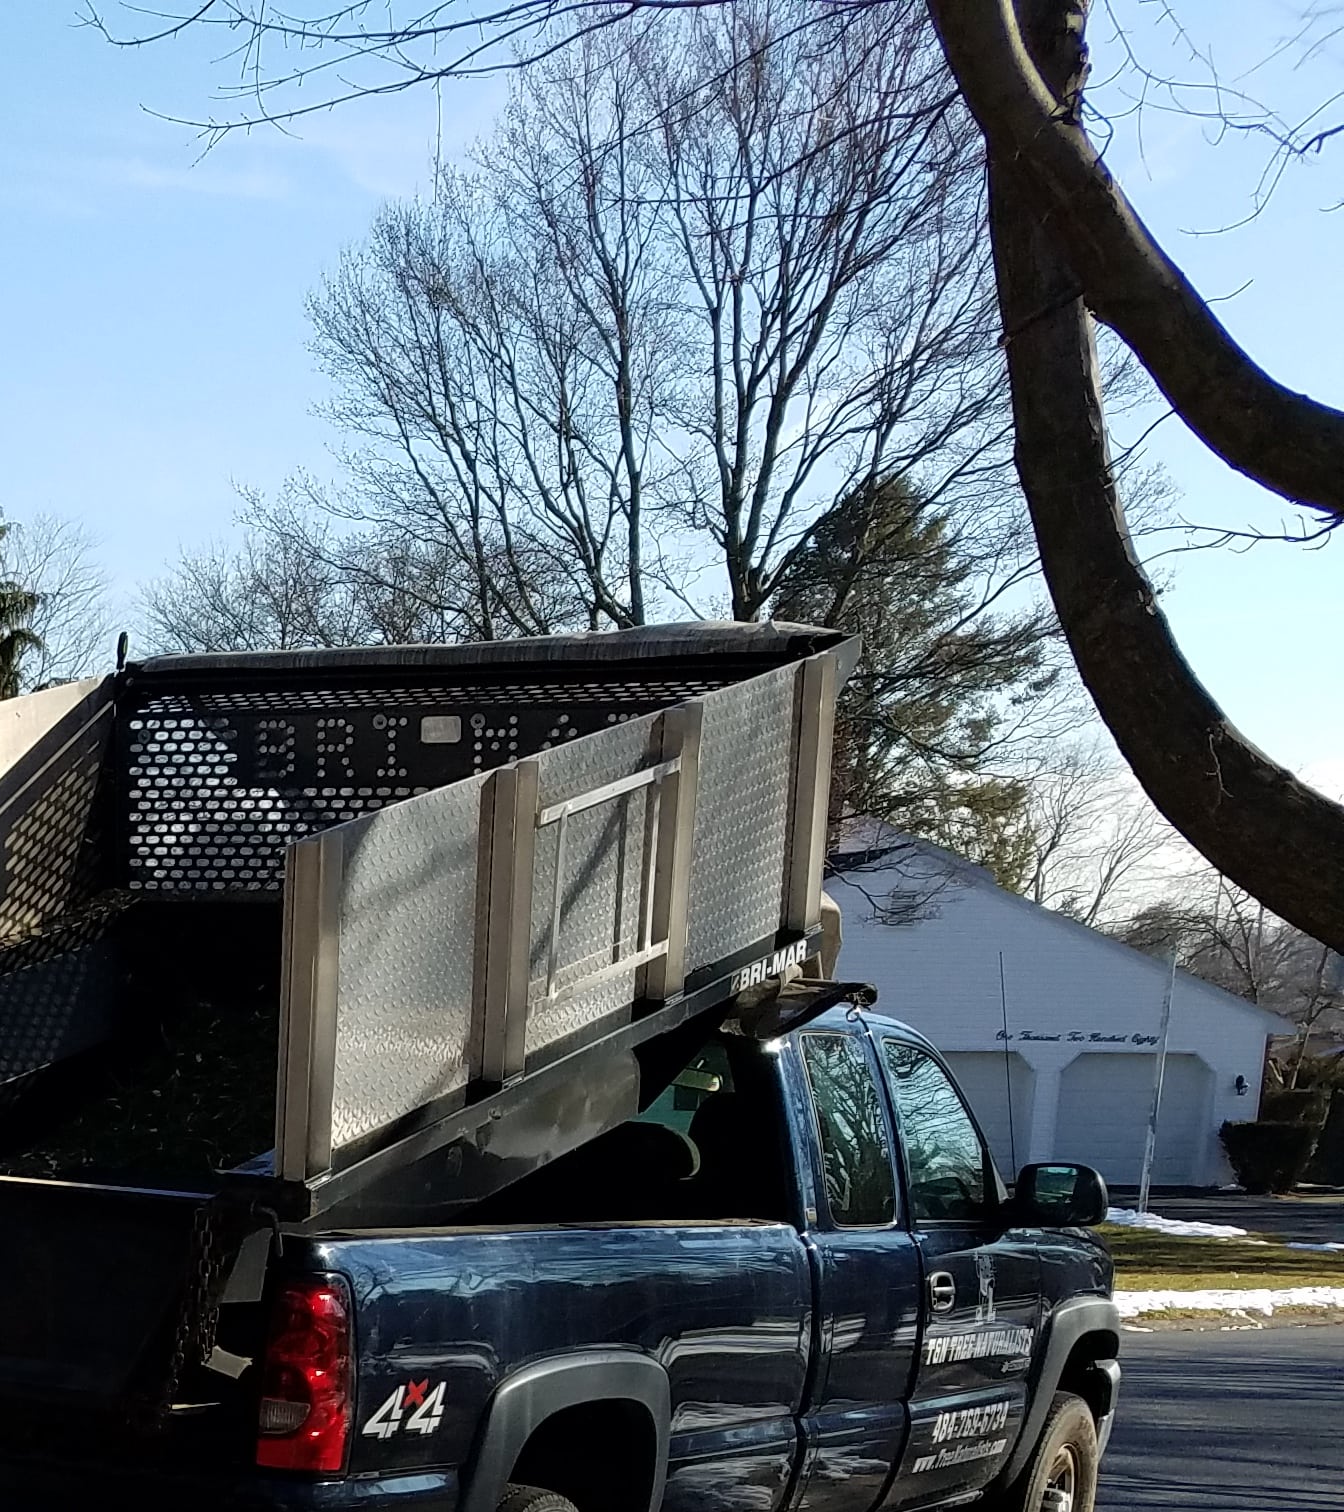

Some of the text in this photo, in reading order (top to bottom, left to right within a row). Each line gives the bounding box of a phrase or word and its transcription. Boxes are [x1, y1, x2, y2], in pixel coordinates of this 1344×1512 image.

[739, 940, 807, 991] BRI-MAR
[1067, 1031, 1085, 1042] Two
[932, 1401, 1009, 1444] 484-769-6734
